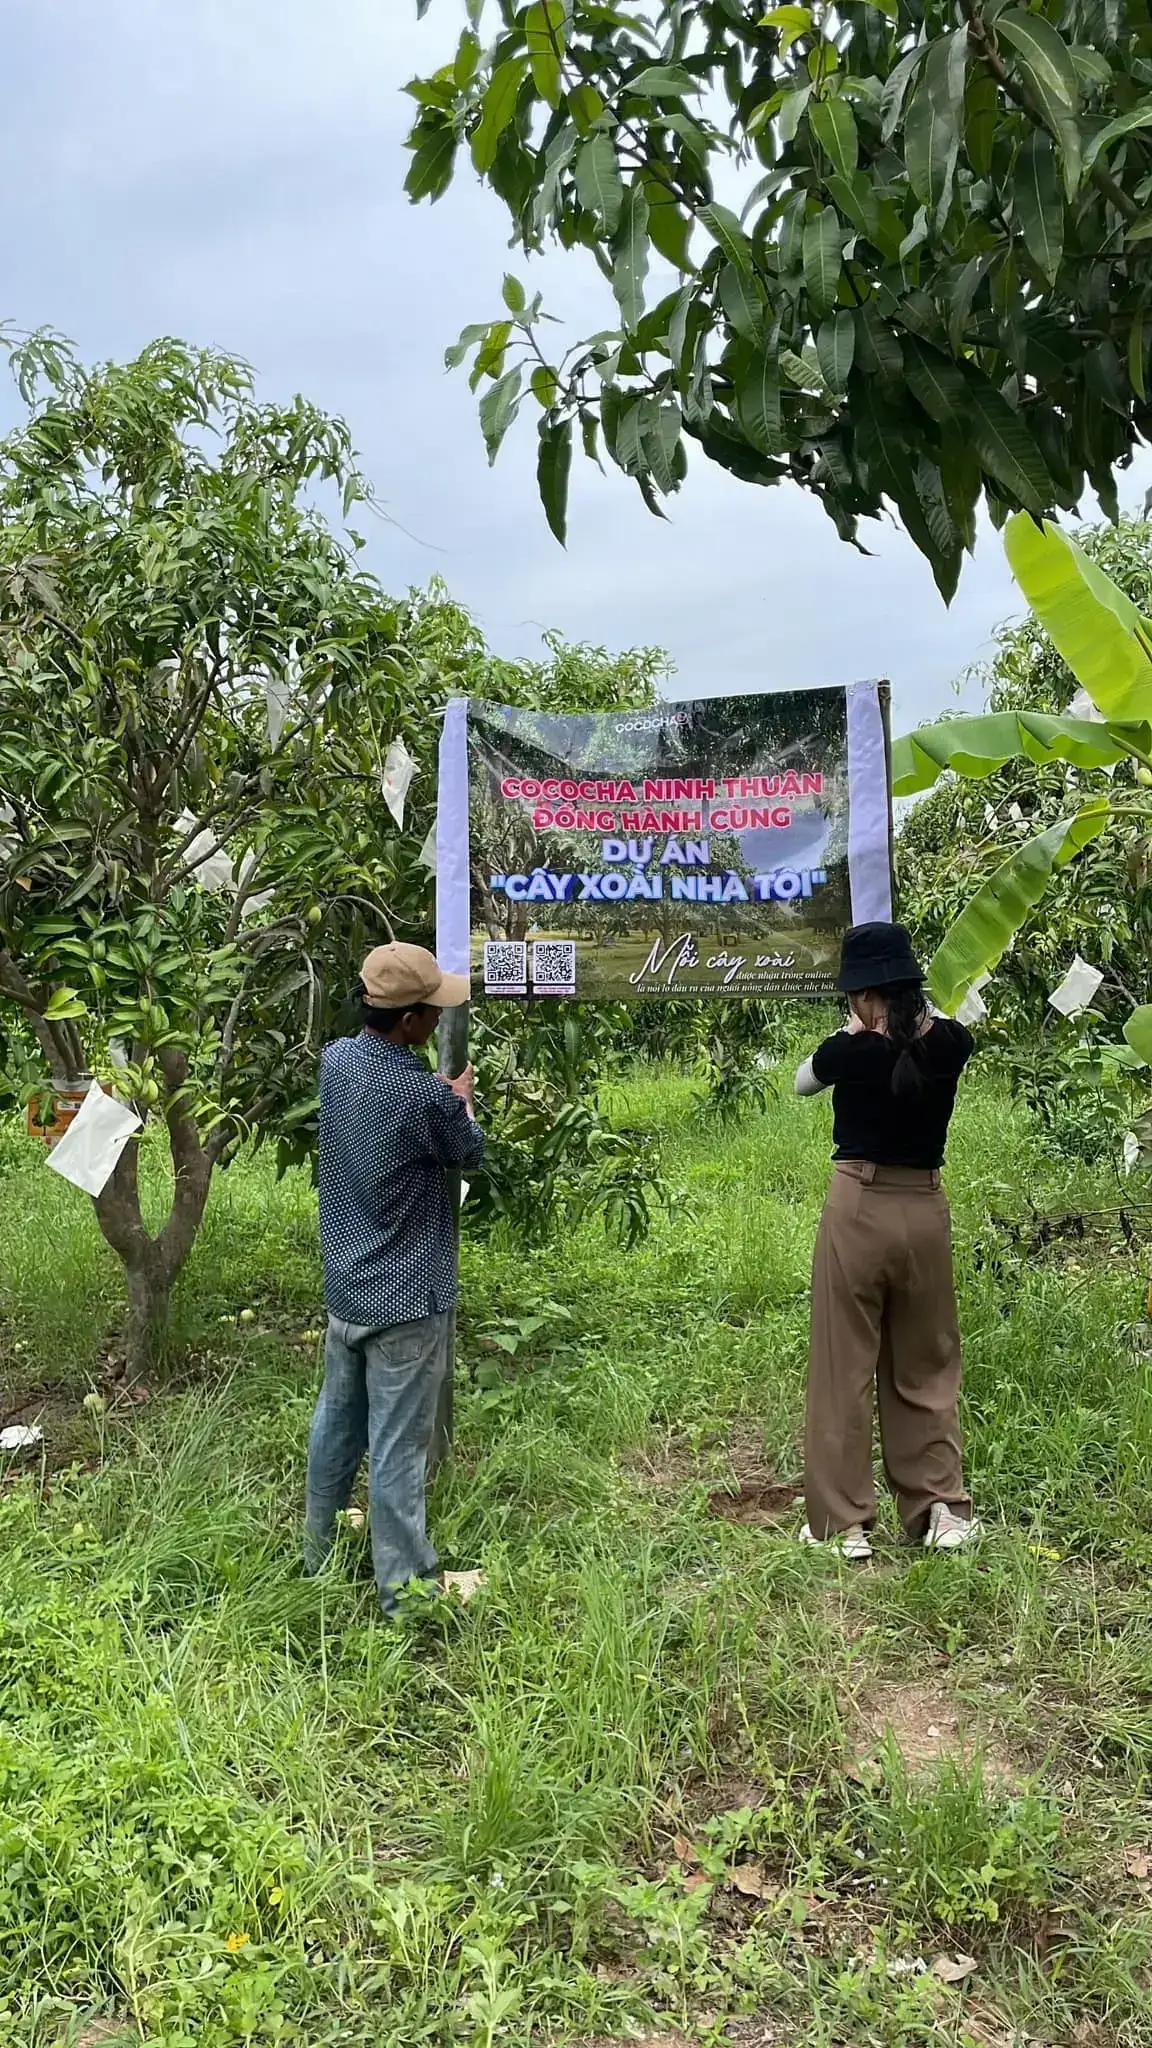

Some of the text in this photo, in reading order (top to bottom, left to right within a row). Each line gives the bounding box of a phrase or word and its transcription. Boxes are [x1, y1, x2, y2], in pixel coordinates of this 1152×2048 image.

[615, 715, 680, 733] COCOCHA
[501, 769, 824, 802] COCOCHA NINH THUẬN
[532, 802, 793, 833] ĐỒNG HÀNH CÙNG
[602, 834, 712, 870] DỰ ÁN
[489, 866, 828, 902] "CÂY XOÀI NHÀ TÔI"
[629, 932, 796, 984] Mỗi cây xoài
[804, 971, 832, 979] online
